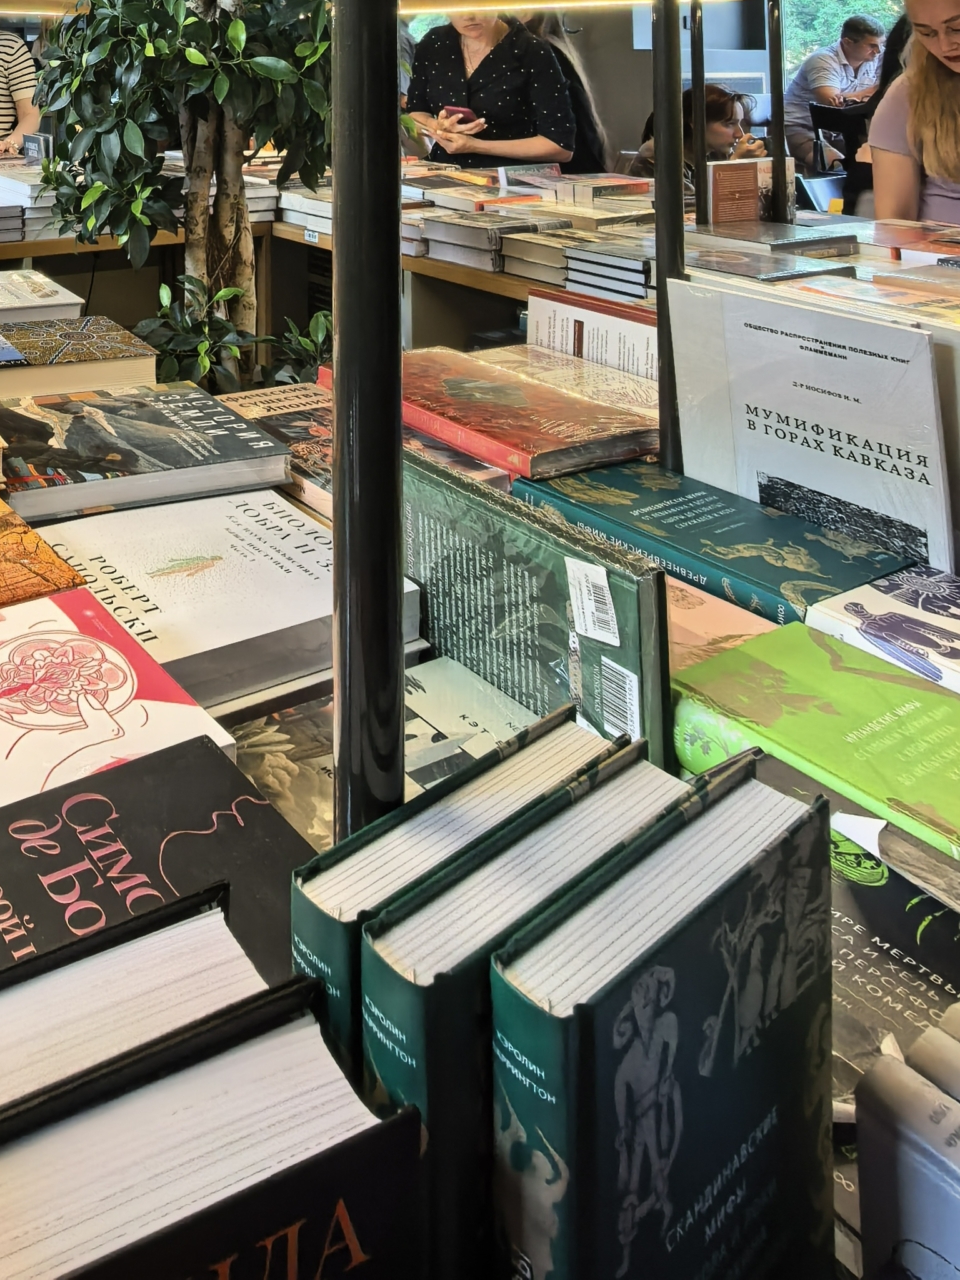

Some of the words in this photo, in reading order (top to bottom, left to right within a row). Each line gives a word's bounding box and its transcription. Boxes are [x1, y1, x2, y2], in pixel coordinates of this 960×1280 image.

[744, 322, 779, 335] ОБЩЕСТВО
[780, 330, 847, 351] РАСПРОСТРАНЕНИЯ
[848, 346, 889, 361] ПОЛЕЗНЫХ
[890, 356, 911, 366] КНИГ
[159, 394, 229, 436] ЗЕМЛИ
[221, 385, 311, 404] ФИЧЕСКИЕ
[239, 391, 324, 408] СУЩЕСТВА
[805, 384, 842, 399] ИОСИФОВ
[184, 391, 275, 449] ИСТОРИЯ
[745, 403, 930, 468] МУМИФИКАЦИЯ
[747, 419, 757, 431] В
[763, 424, 826, 452] ГОРАХ
[832, 444, 933, 486] КАВКАЗА
[228, 500, 295, 542] ДОБРА
[294, 542, 316, 554] И
[262, 502, 333, 549] БИОЛО
[577, 521, 607, 540] МИФЫ
[52, 542, 160, 644] САПОЛЬСКИ
[89, 555, 163, 615] РОБЕРТ
[592, 664, 601, 716] SYMPOSIUM
[8, 814, 63, 858] де
[61, 792, 165, 915] Симо
[839, 948, 944, 1021] ПЕРСЕФО
[863, 947, 878, 958] И
[884, 961, 939, 1001] ХЕЛЬ
[872, 936, 960, 999] МЕРТВЫ
[852, 975, 932, 1030] КОМЕД
[665, 1104, 779, 1253] СКАНДИНАВСКИЕ
[705, 1177, 747, 1246] МИФЫ
